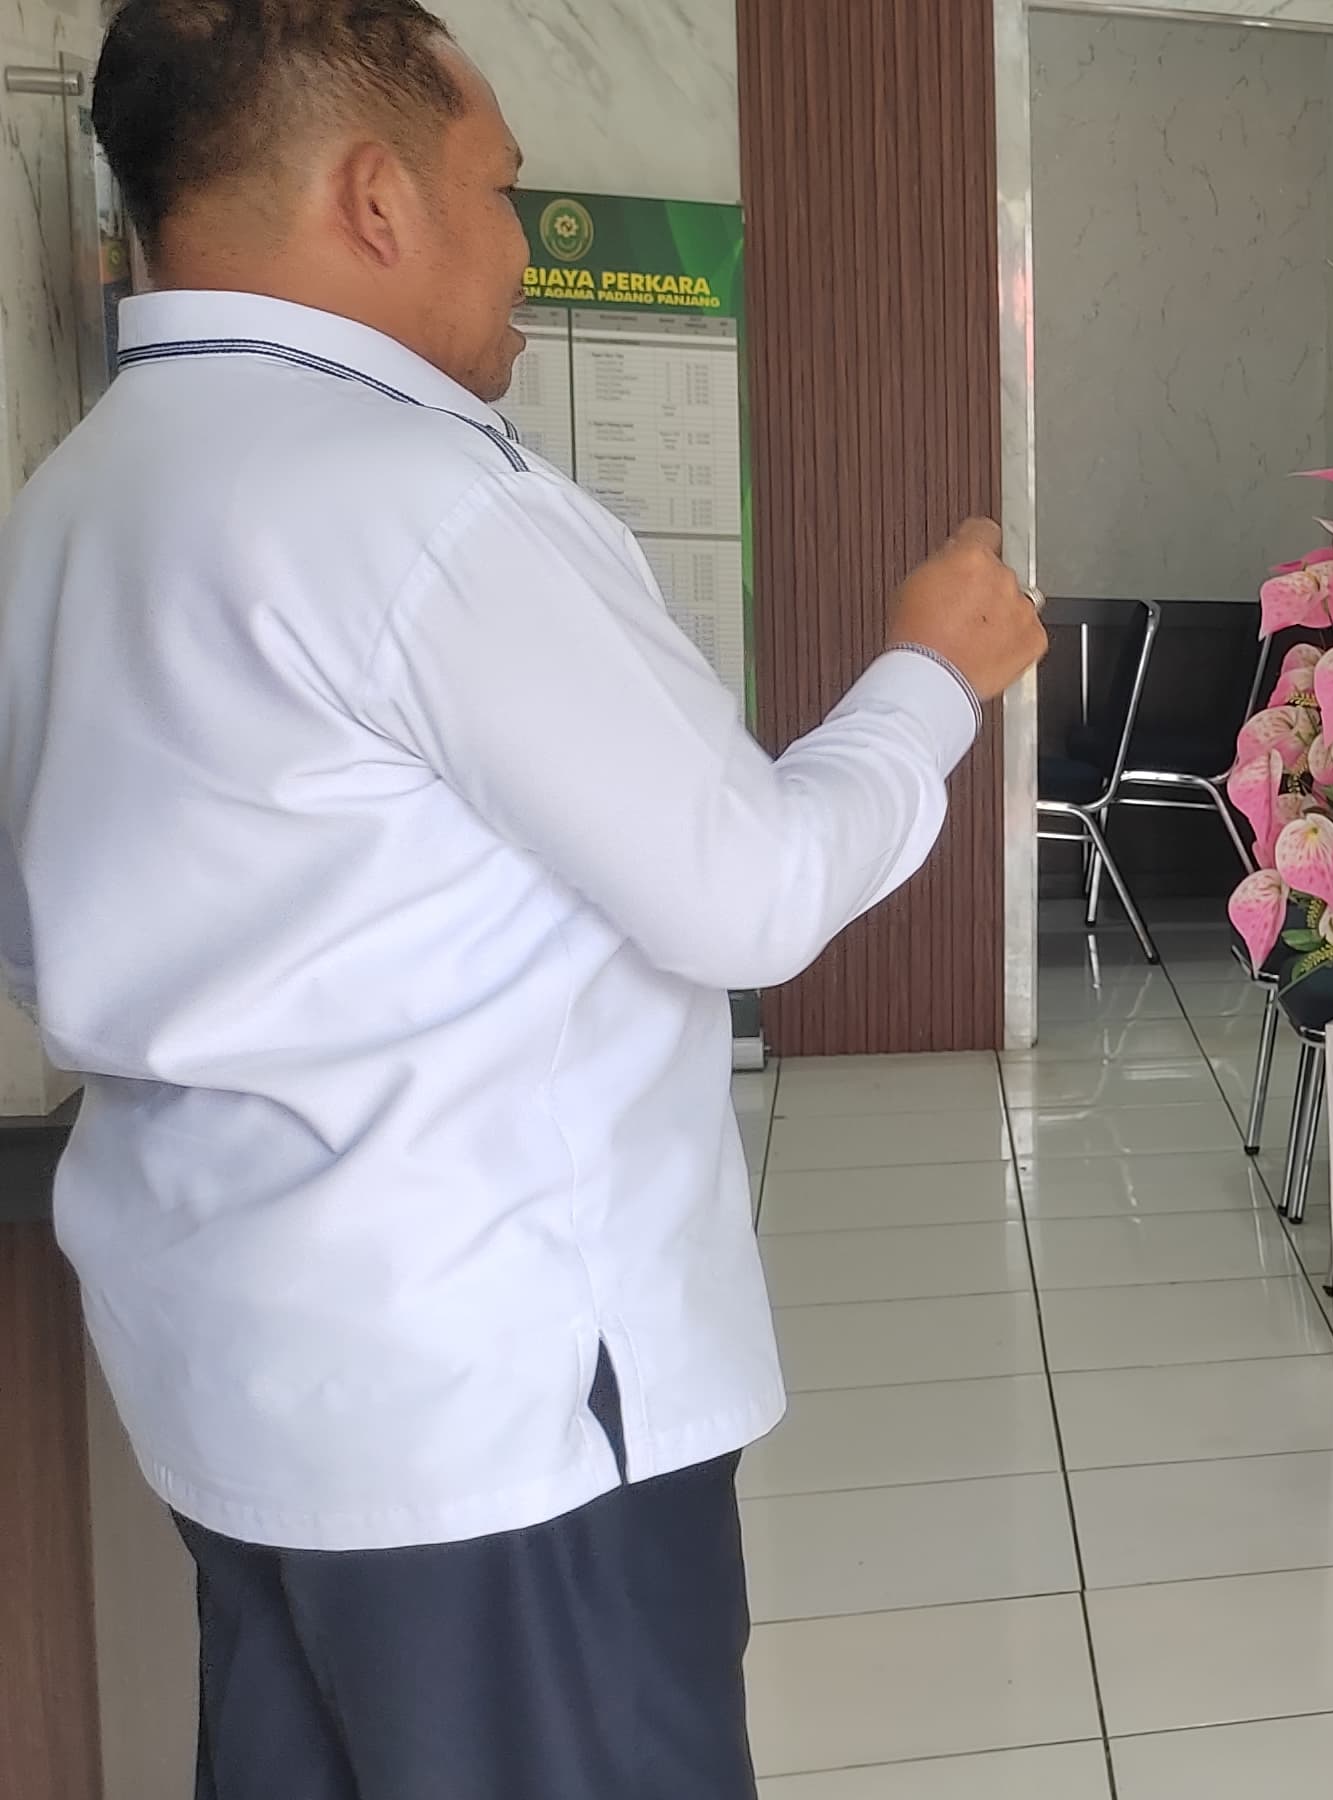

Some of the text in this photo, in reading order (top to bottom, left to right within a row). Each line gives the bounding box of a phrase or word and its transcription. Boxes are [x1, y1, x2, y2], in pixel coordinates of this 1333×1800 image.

[523, 266, 711, 295] BIAYA PERKARA
[544, 288, 595, 300] AGAMA
[597, 290, 654, 304] PADANG
[657, 294, 721, 308] PANJANG
